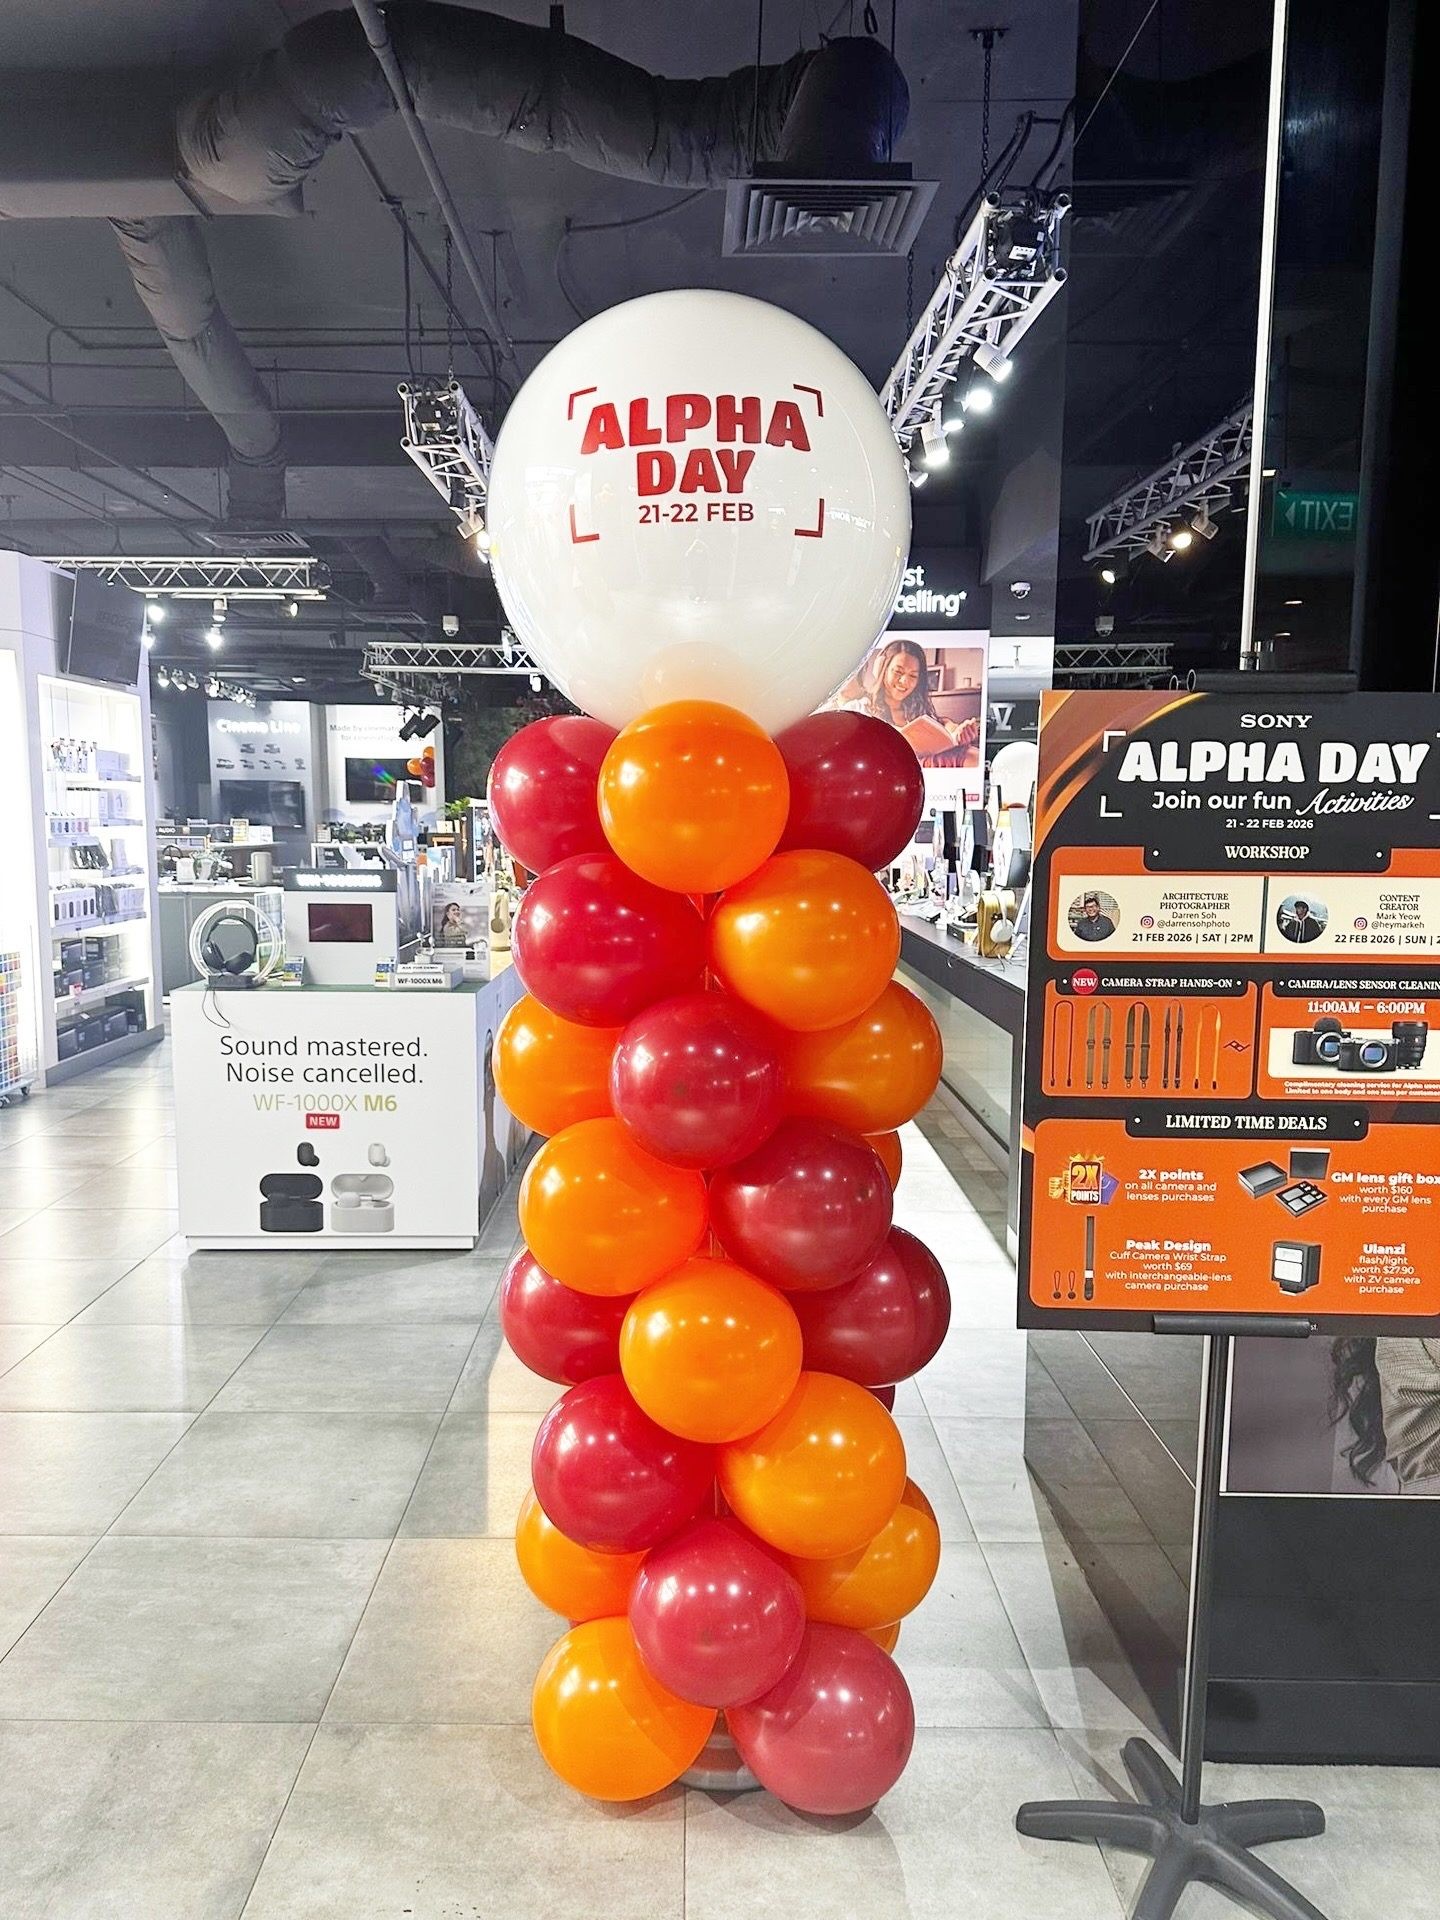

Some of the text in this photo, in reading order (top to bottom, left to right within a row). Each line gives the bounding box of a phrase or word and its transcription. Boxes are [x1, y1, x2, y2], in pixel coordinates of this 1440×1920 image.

[581, 394, 811, 454] ALPHA
[637, 448, 756, 496] DAY
[638, 503, 754, 524] 21-22 FEB
[903, 565, 925, 587] st
[893, 590, 967, 617] celling
[1240, 714, 1312, 729] SONY
[1117, 741, 1430, 784] ALPHA DAY
[1152, 788, 1415, 816] Join our fun Activities
[1226, 819, 1238, 829] 21
[1246, 819, 1260, 829] 22
[1262, 819, 1285, 829] FEB
[1286, 819, 1314, 829] 2026
[1225, 845, 1309, 859] WORKSHOP
[1162, 893, 1229, 901] ARCHITECTURE
[1380, 894, 1420, 902] CONTENT
[1160, 902, 1230, 910] PHOTOGRAPHER
[1376, 912, 1397, 920] Mark
[1157, 920, 1231, 928] @darrensohphoto
[1371, 921, 1425, 929] @heymarkeh
[1132, 933, 1143, 942] 21
[1146, 933, 1165, 942] FEB
[1167, 933, 1192, 942] 2026
[1202, 933, 1222, 942] SAT
[1231, 934, 1254, 942] 2PM
[1335, 934, 1347, 943] 22
[1349, 935, 1368, 943] FEB
[1370, 935, 1395, 943] 2026
[1405, 935, 1427, 944] SUN
[1072, 977, 1097, 986] NEW
[1101, 977, 1233, 988] CAMERA STRAP HANDS-ON
[1288, 979, 1440, 990] CAMERA/LENS SENSOR CLEANIN
[1307, 1001, 1360, 1013] 11:00AM
[1377, 1002, 1426, 1014] 6:00PM
[220, 1035, 428, 1057] Sound mastered.
[226, 1062, 424, 1084] Noise cancelled.
[253, 1094, 398, 1112] WF-1000X M6
[309, 1116, 338, 1127] NEW
[1166, 1114, 1328, 1130] LIMITED TIME DEALS
[1071, 1165, 1098, 1190] 2X
[1138, 1168, 1204, 1182] 2X points
[1331, 1171, 1440, 1185] GM lens gift box
[1141, 1182, 1153, 1190] all
[1154, 1183, 1194, 1191] camera
[1196, 1182, 1217, 1191] and
[1359, 1185, 1413, 1195] worth $160
[1071, 1190, 1099, 1202] POINTS
[1127, 1191, 1215, 1203] lenses purchases
[1339, 1194, 1361, 1202] with
[1363, 1196, 1390, 1205] every
[1411, 1196, 1432, 1204] lens
[1362, 1205, 1408, 1214] purchase
[1126, 1239, 1212, 1253] Peak Design
[1362, 1243, 1406, 1255] Ulanzi
[1109, 1251, 1227, 1263] Cuff Camera Wrist Strap
[1359, 1255, 1408, 1266] flash/light
[1143, 1262, 1193, 1271] worth $69
[1352, 1266, 1414, 1275] worth $27.90
[1105, 1271, 1232, 1282] with interchangeable-lens
[1344, 1275, 1421, 1285] with ZV camera
[1124, 1281, 1209, 1292] camera purchase
[1359, 1285, 1404, 1294] purchase
